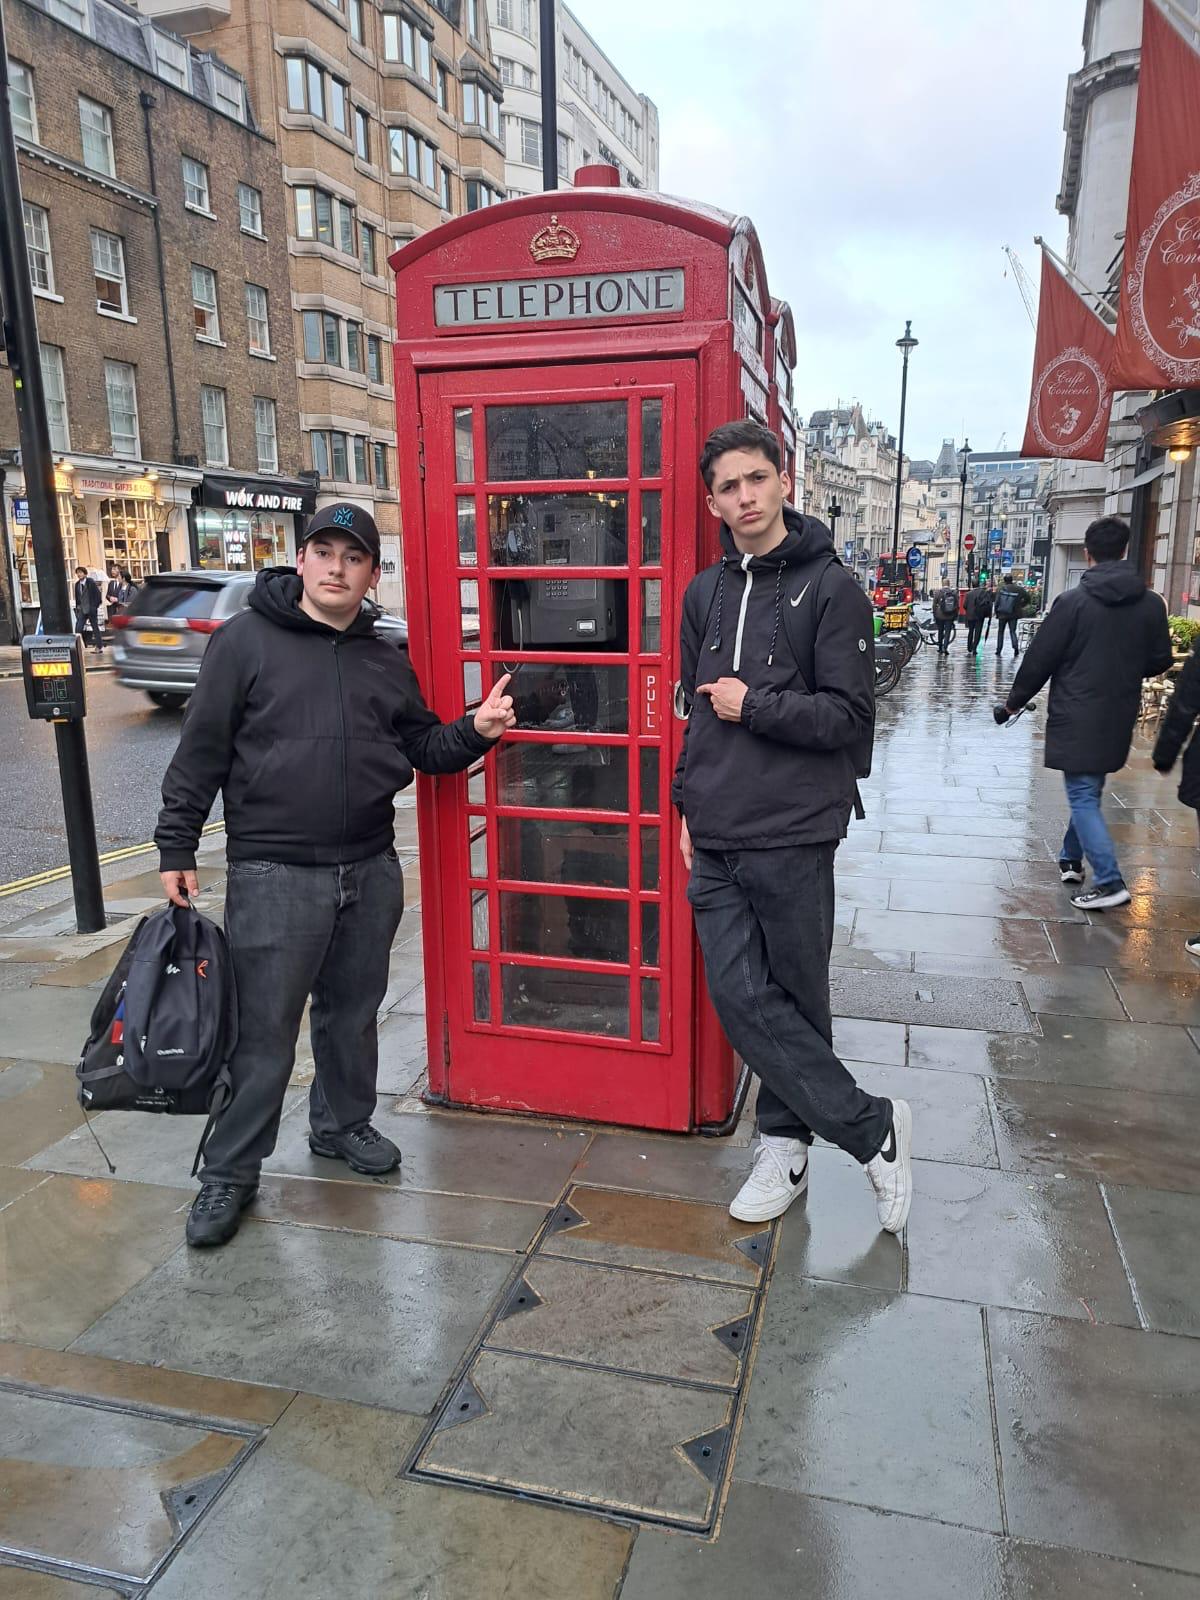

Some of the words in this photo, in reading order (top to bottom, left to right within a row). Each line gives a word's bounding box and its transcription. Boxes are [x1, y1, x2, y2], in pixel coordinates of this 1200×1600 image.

[443, 275, 674, 322] TELEPHONE
[115, 482, 133, 492] GIFTS
[225, 488, 254, 507] WOK
[256, 494, 280, 509] AND
[282, 496, 303, 511] FIRE
[223, 530, 247, 542] WOK
[229, 544, 243, 552] AND
[227, 552, 247, 564] FIRE
[35, 663, 69, 676] WAIT
[647, 675, 656, 728] PULL
